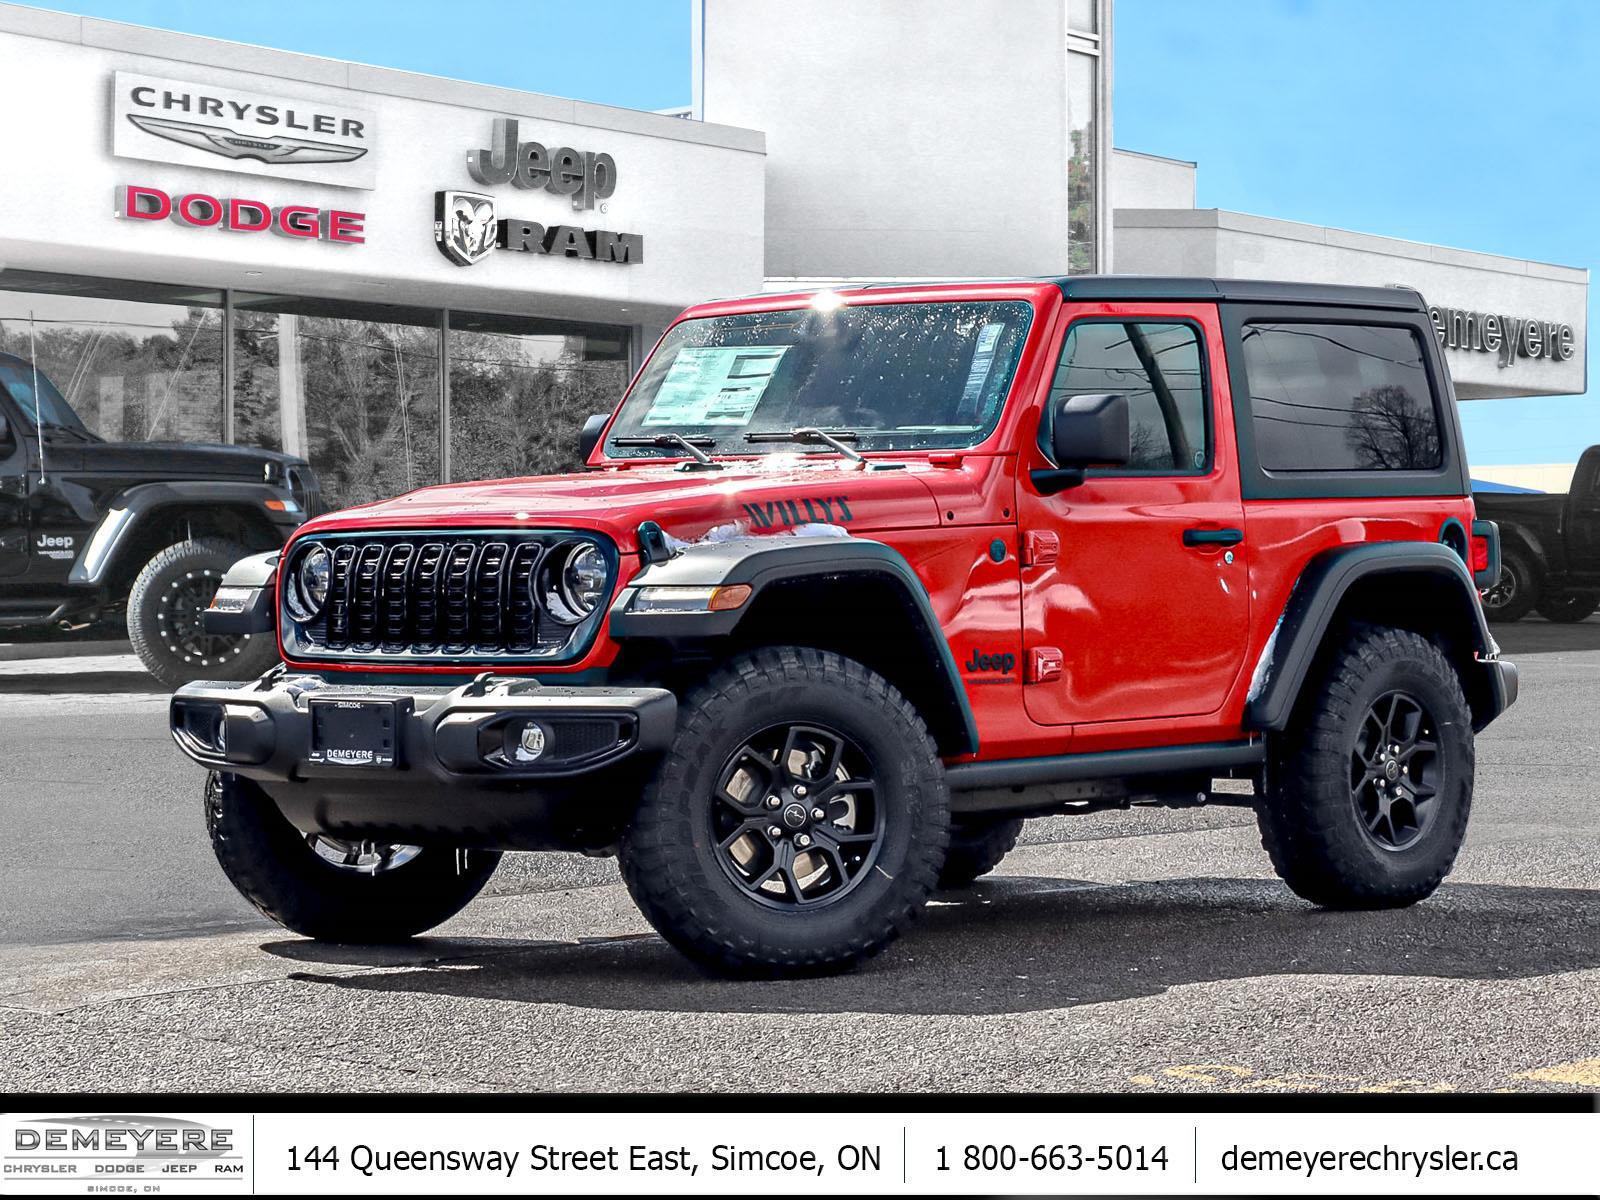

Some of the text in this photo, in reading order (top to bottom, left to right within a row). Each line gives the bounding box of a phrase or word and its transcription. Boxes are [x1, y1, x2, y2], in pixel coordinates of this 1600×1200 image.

[130, 86, 365, 138] CHRYSLER
[467, 118, 617, 210] Jeep
[115, 185, 366, 244] DODGE
[497, 218, 644, 264] RAM
[1427, 304, 1575, 367] emeyere
[742, 496, 852, 528] WILLYS
[37, 534, 74, 548] Jeep
[966, 648, 1016, 674] Jeep
[326, 748, 373, 759] DEMEYERE
